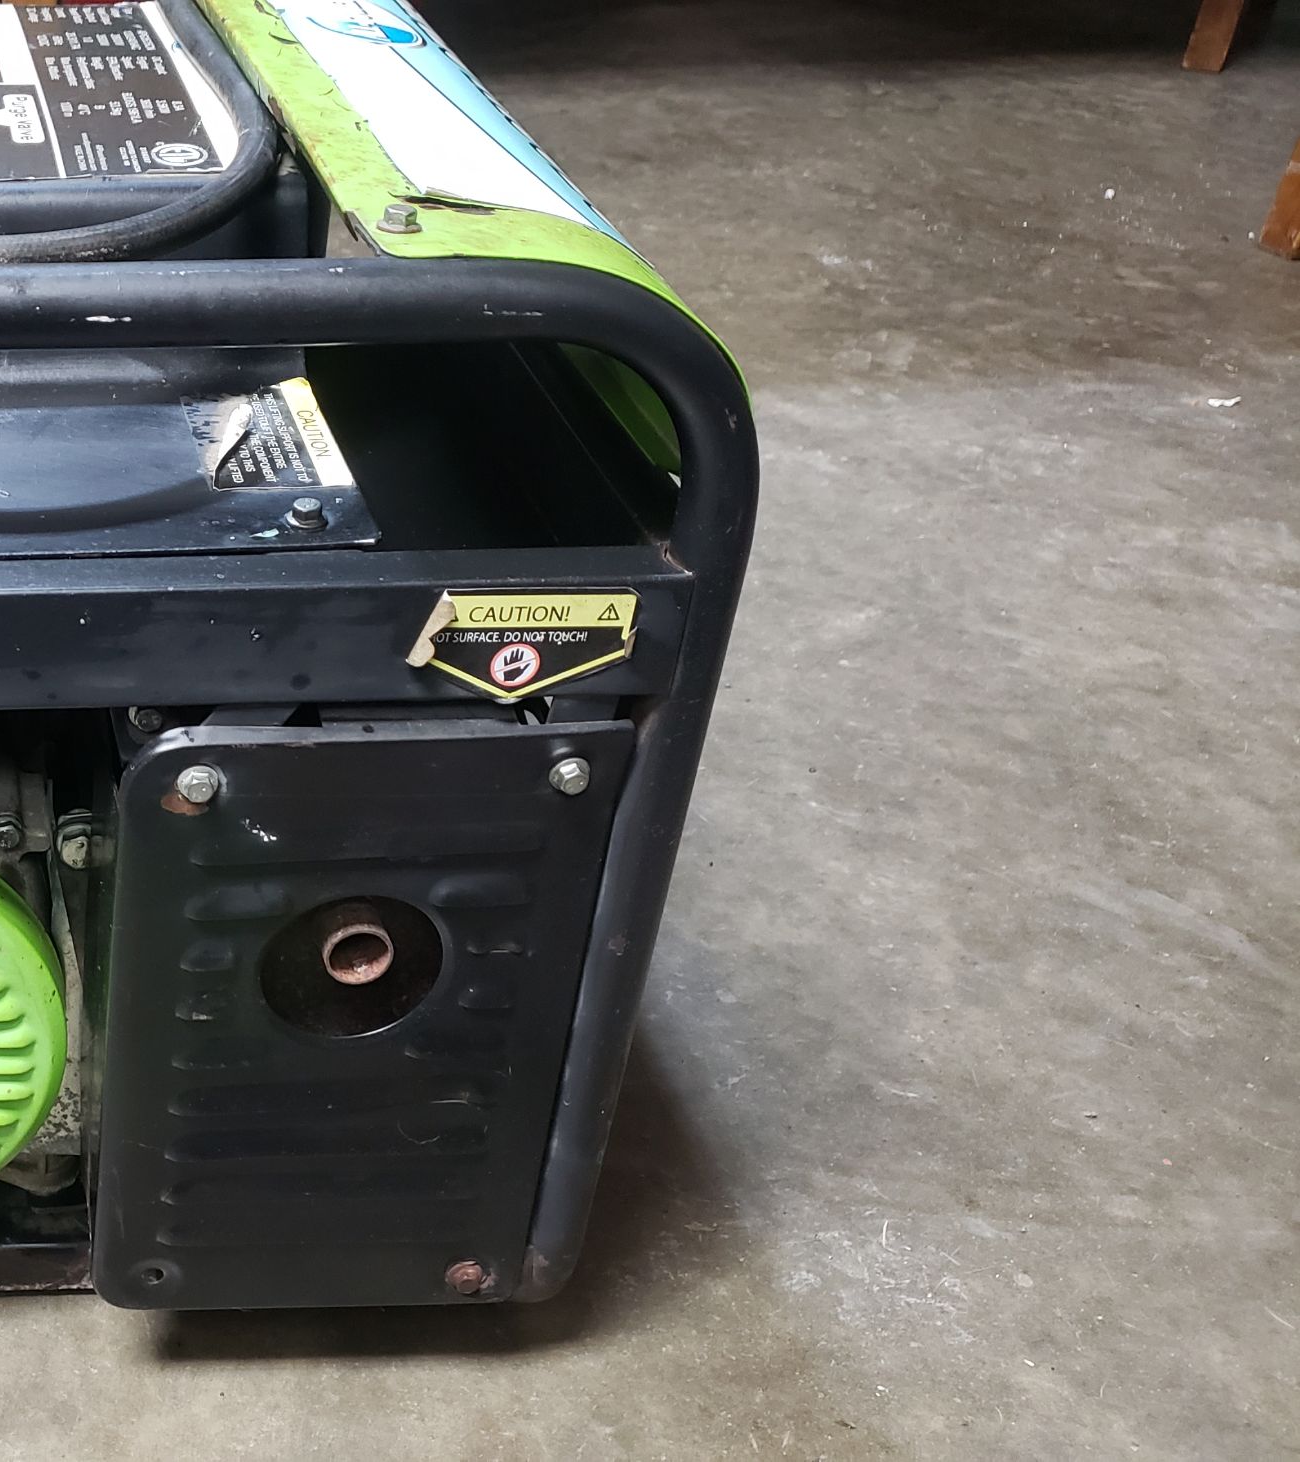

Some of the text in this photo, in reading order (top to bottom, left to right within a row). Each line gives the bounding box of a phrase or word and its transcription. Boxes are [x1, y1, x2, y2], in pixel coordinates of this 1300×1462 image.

[9, 96, 27, 118] Purge
[296, 410, 332, 457] CAUTION
[469, 606, 571, 623] CAUTION!
[452, 631, 501, 643] SURFACE.
[503, 631, 521, 643] DO
[523, 631, 544, 643] NOT
[548, 631, 588, 644] TOUCH!
